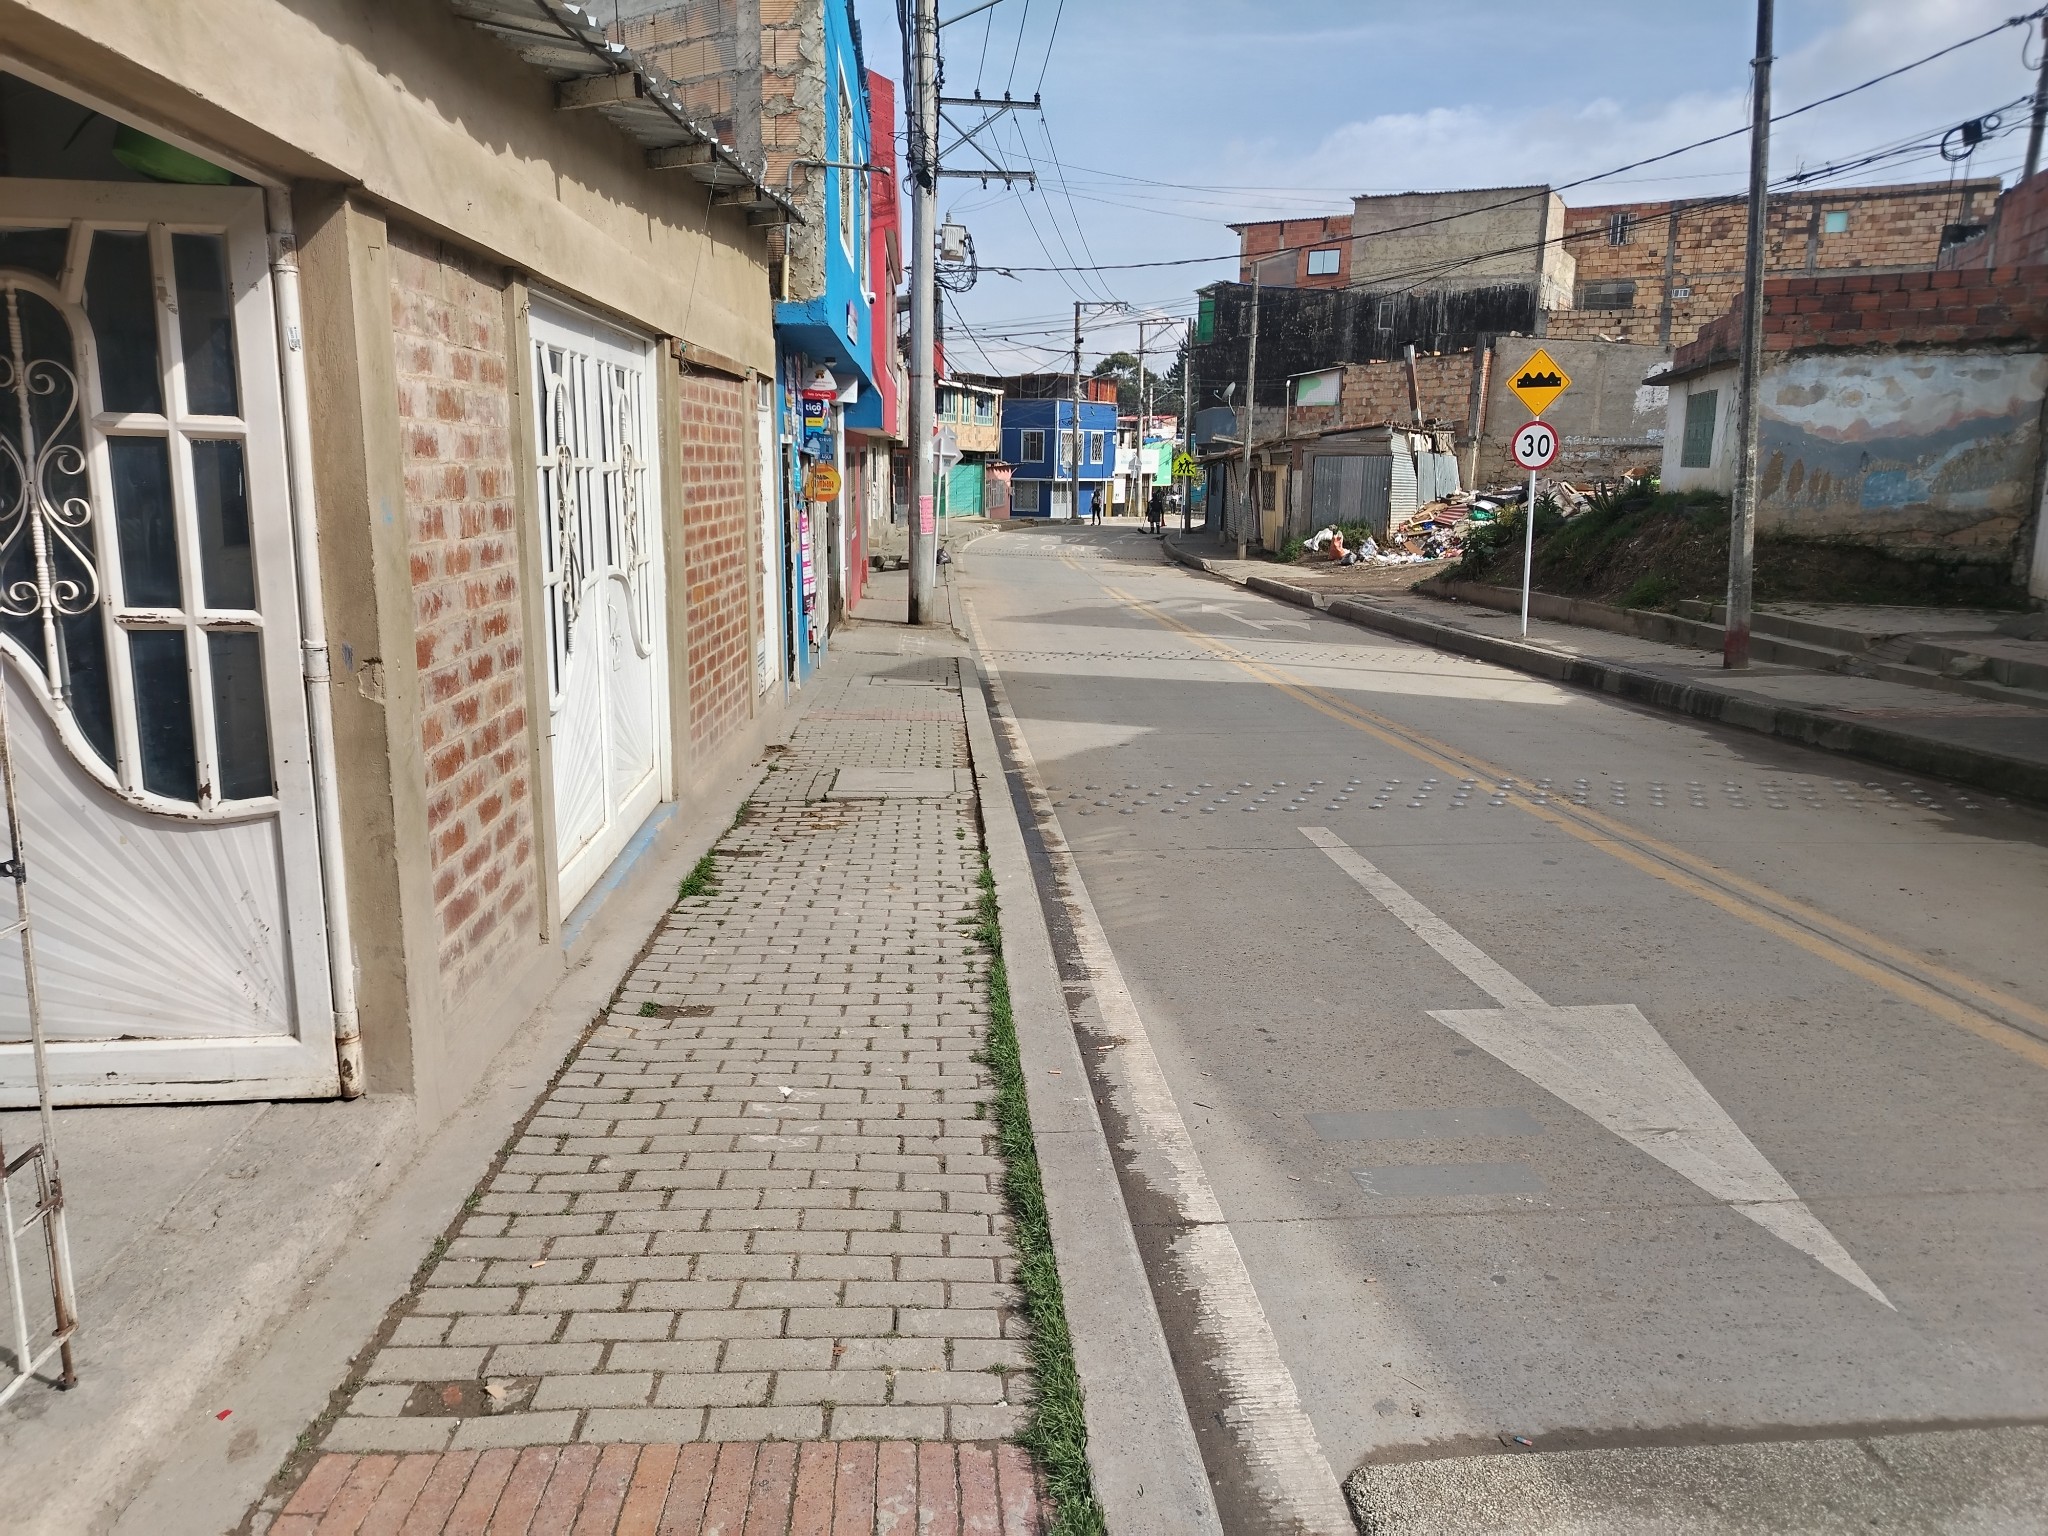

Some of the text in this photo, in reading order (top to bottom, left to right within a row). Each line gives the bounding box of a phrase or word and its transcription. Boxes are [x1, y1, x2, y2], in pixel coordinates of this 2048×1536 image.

[805, 403, 822, 415] tigo
[1522, 434, 1550, 457] 30
[1014, 543, 1113, 553] ZONA
